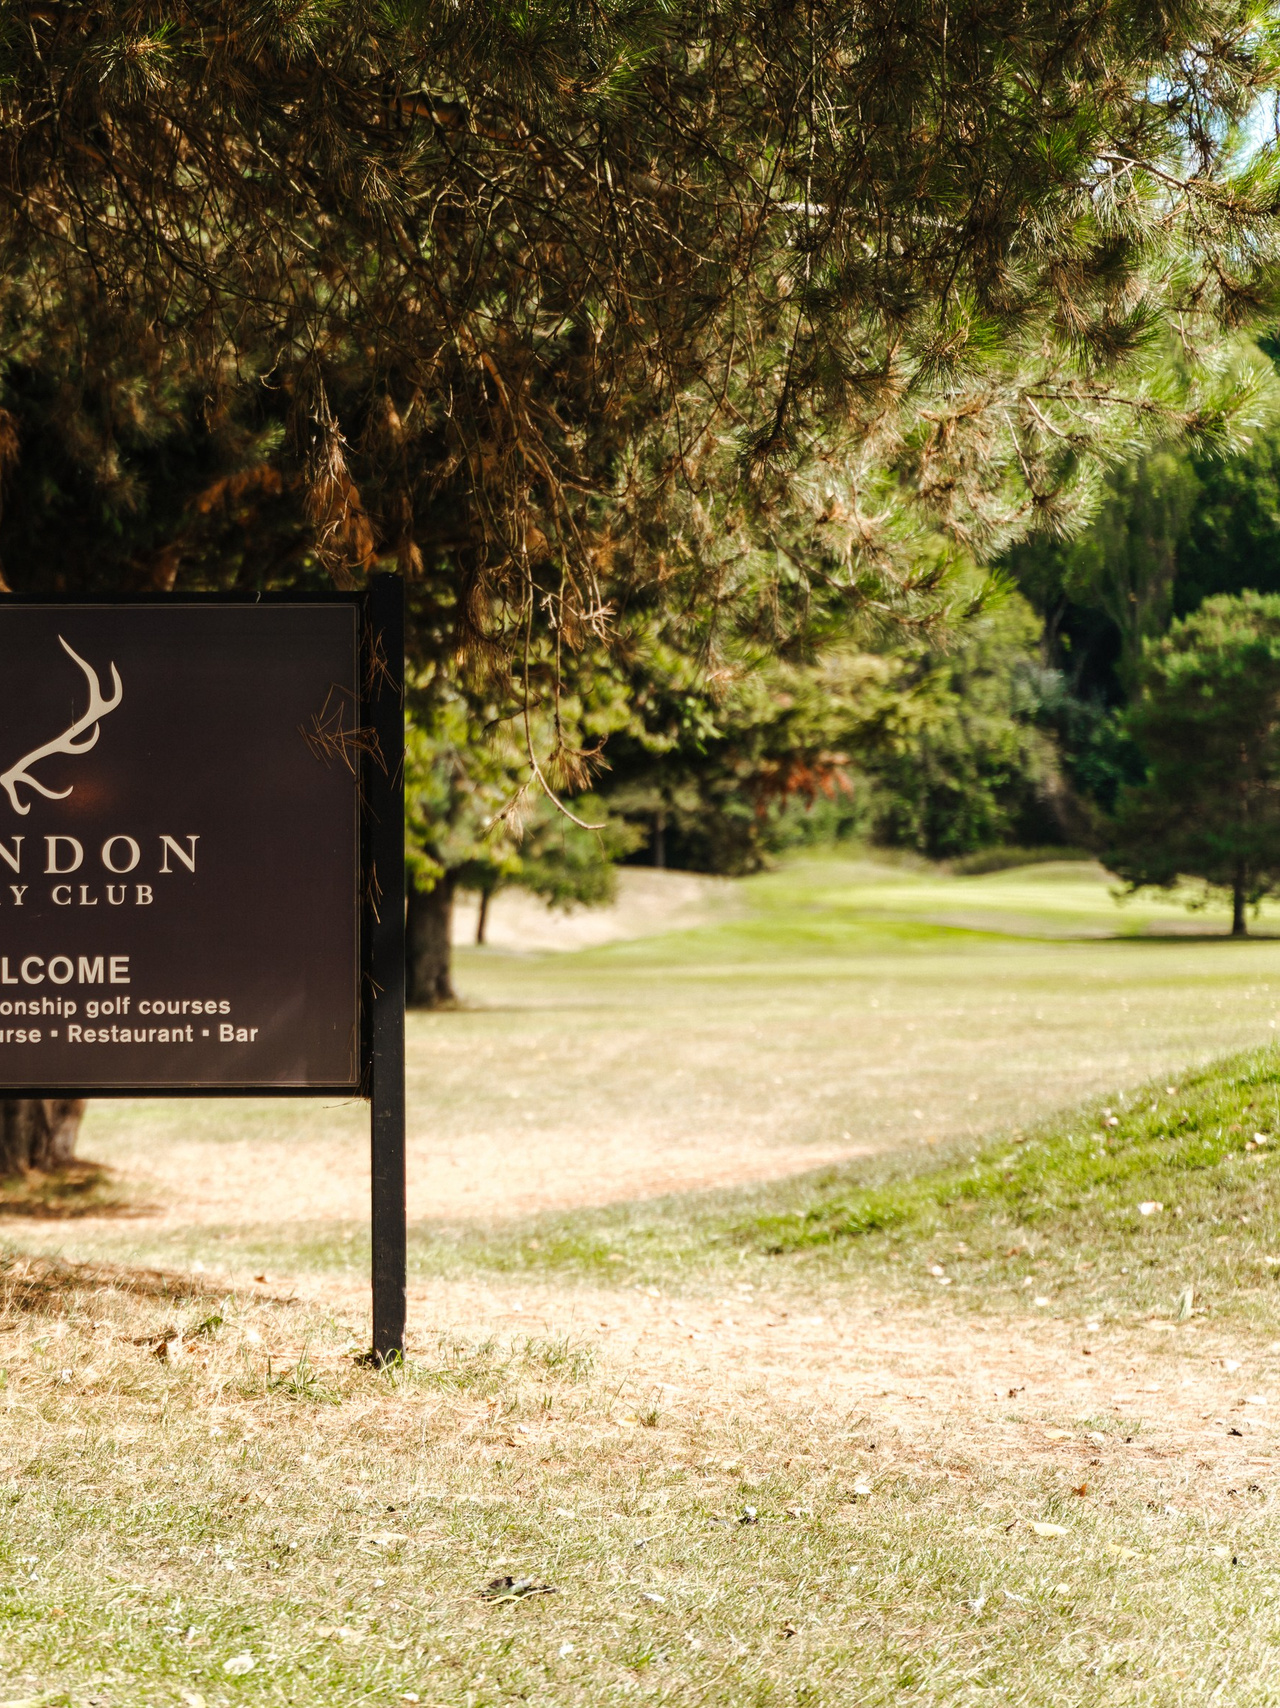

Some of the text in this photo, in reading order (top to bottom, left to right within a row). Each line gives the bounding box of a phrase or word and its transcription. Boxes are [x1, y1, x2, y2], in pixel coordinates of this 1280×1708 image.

[51, 884, 154, 906] CLUB
[85, 996, 131, 1019] golf
[138, 1000, 231, 1015] courses
[67, 1023, 194, 1043] Restaurant
[218, 1023, 259, 1043] Bar
